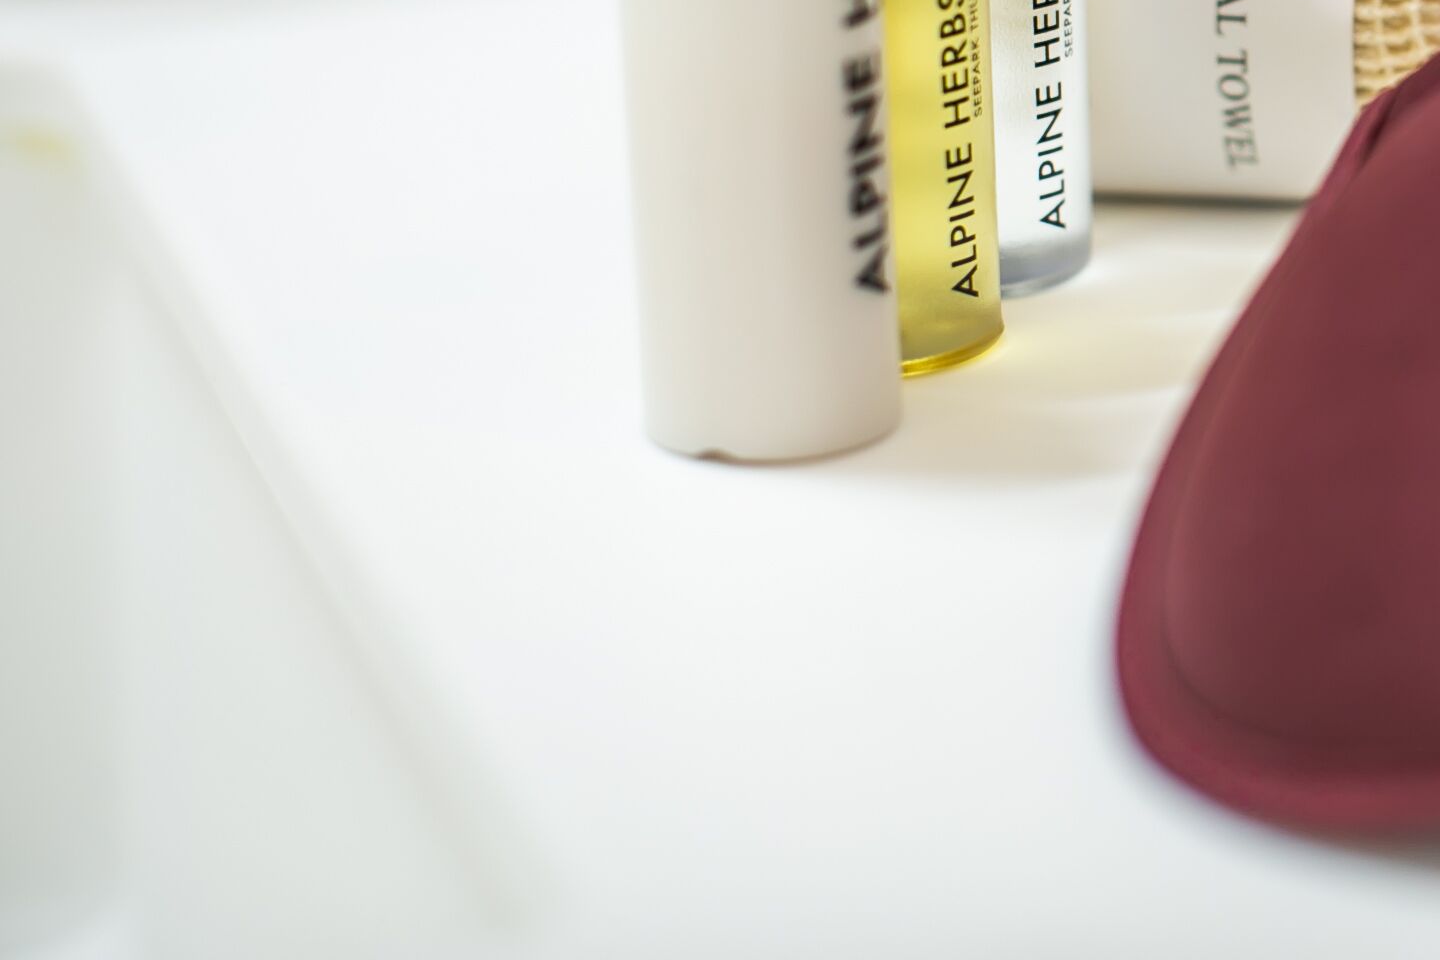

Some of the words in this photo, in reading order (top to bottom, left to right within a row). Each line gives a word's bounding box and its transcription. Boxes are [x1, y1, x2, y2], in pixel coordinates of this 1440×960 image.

[971, 37, 983, 117] SEEPARK
[1216, 49, 1260, 171] TOWEL
[843, 47, 892, 295] ALPINE
[946, 142, 979, 298] ALPINE
[1036, 81, 1066, 230] ALPINE
